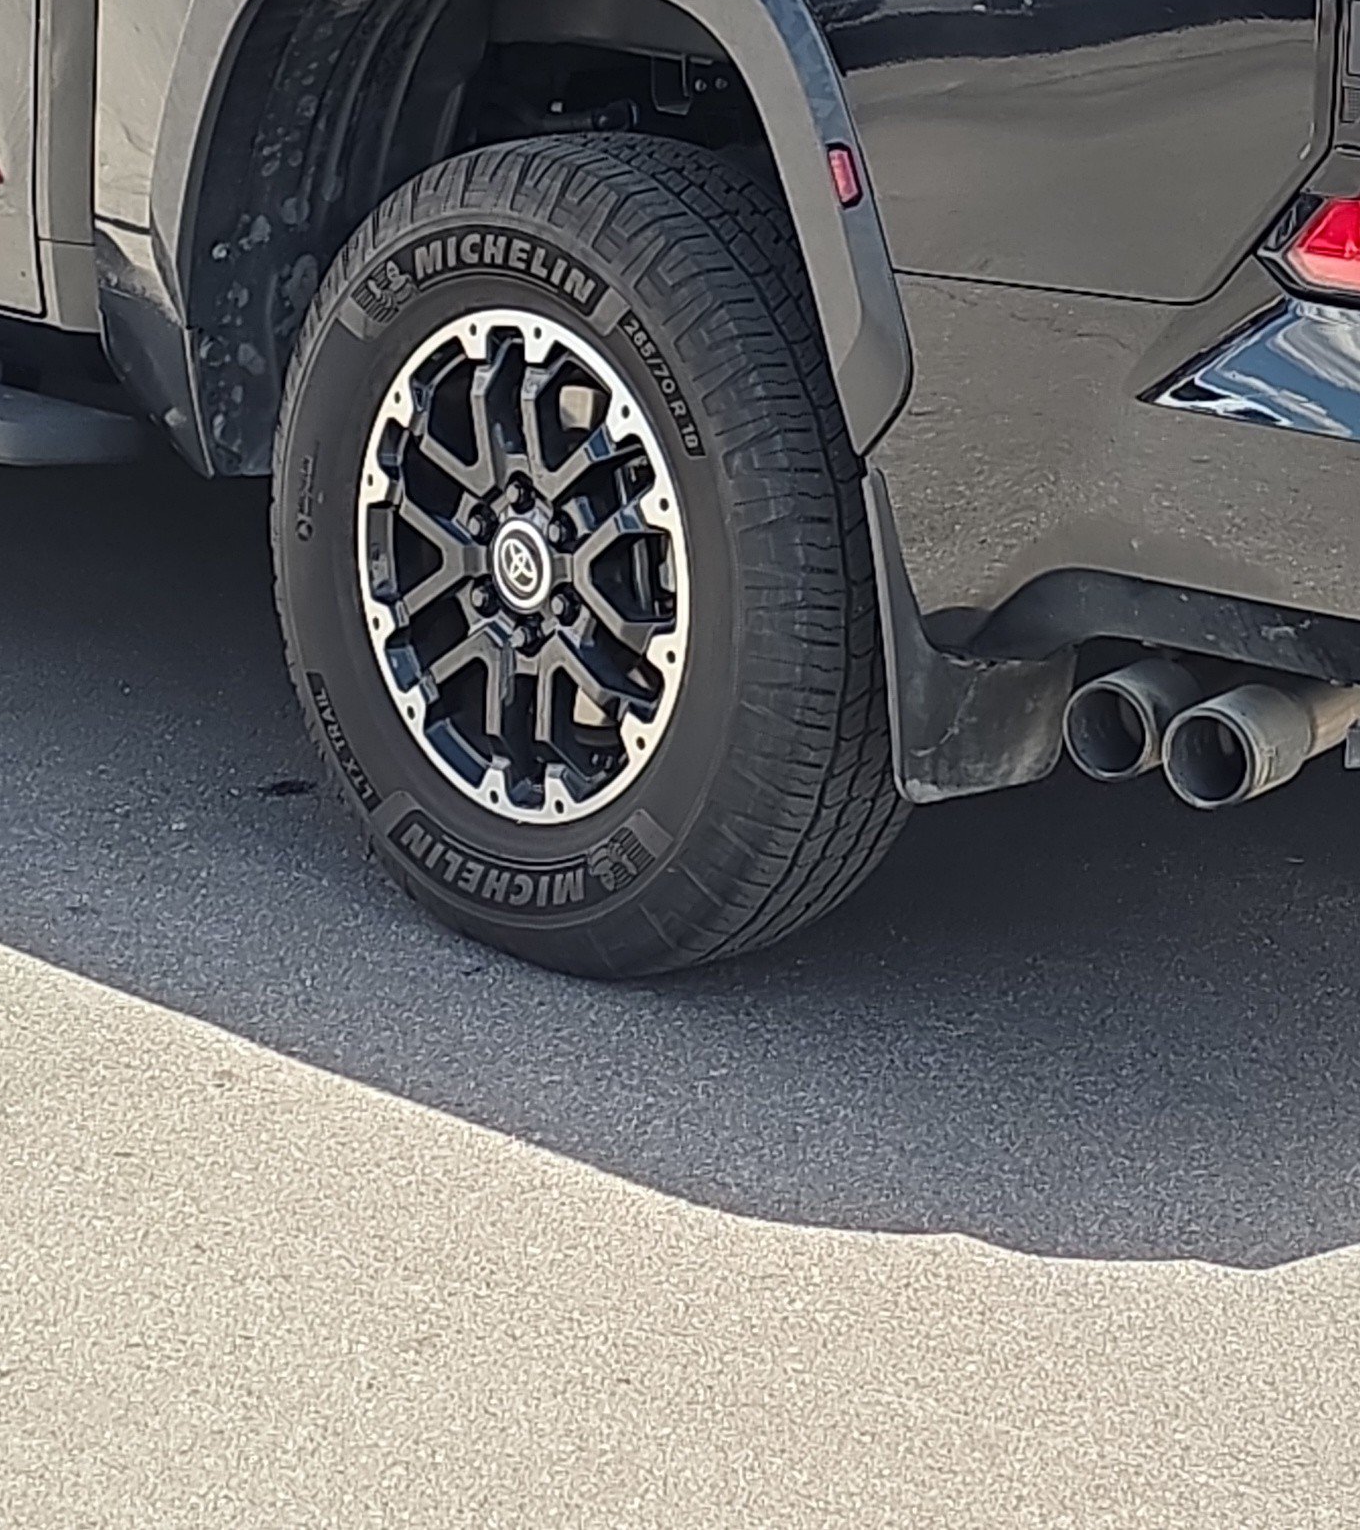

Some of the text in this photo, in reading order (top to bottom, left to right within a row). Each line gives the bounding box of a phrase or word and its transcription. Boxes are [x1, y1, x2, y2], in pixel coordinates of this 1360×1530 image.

[414, 233, 595, 303] MICHELIN
[623, 319, 676, 394] 265/70
[315, 687, 374, 799] LTX TRAIL
[400, 822, 585, 907] MICHELIN
